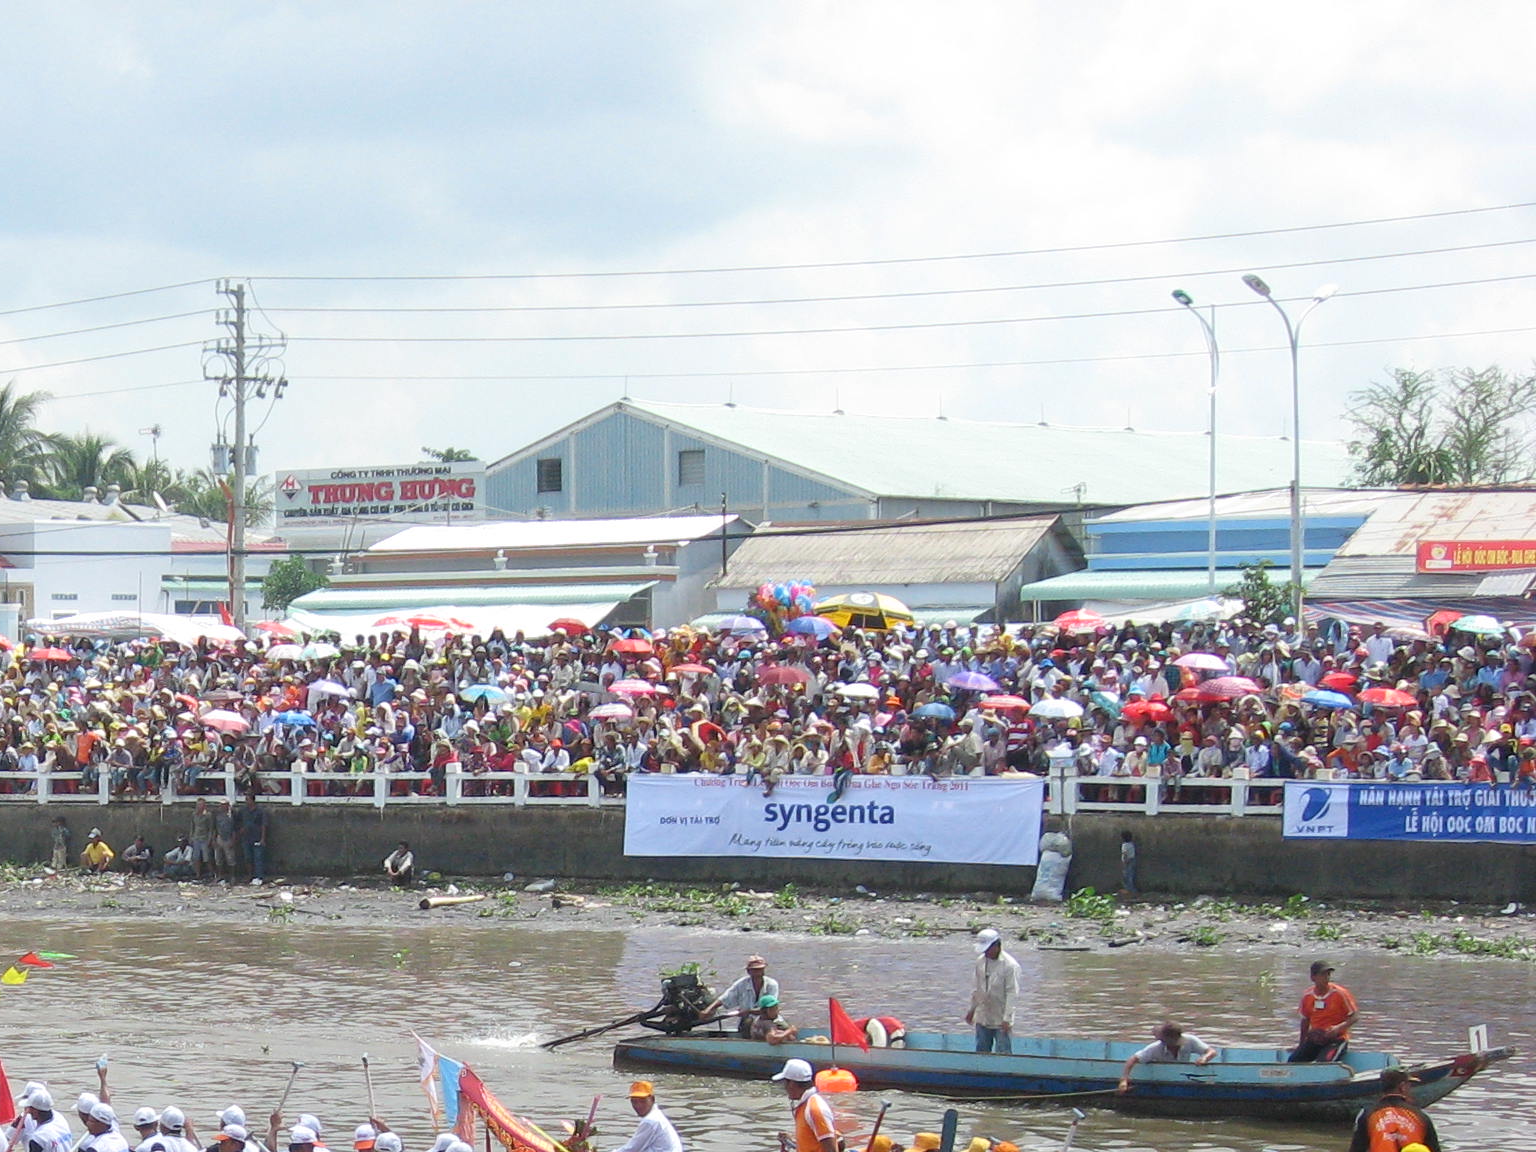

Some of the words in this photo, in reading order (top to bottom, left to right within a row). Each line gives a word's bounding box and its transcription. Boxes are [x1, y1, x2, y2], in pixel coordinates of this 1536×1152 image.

[358, 469, 370, 479] TY
[371, 467, 395, 478] TNHH
[308, 482, 395, 504] TRUNG
[399, 477, 476, 501] HƯNG
[950, 782, 969, 791] 2011
[1387, 788, 1421, 810] HẠNH
[1425, 786, 1444, 807] TÀI
[1447, 788, 1472, 811] TRỢ
[764, 800, 895, 832] syngenta
[1405, 808, 1418, 833] LỄ
[1422, 811, 1444, 838] HỘI
[1447, 815, 1473, 833] OOC
[1475, 815, 1495, 833] OM
[1499, 816, 1524, 834] BOC
[1296, 825, 1334, 833] VNPT
